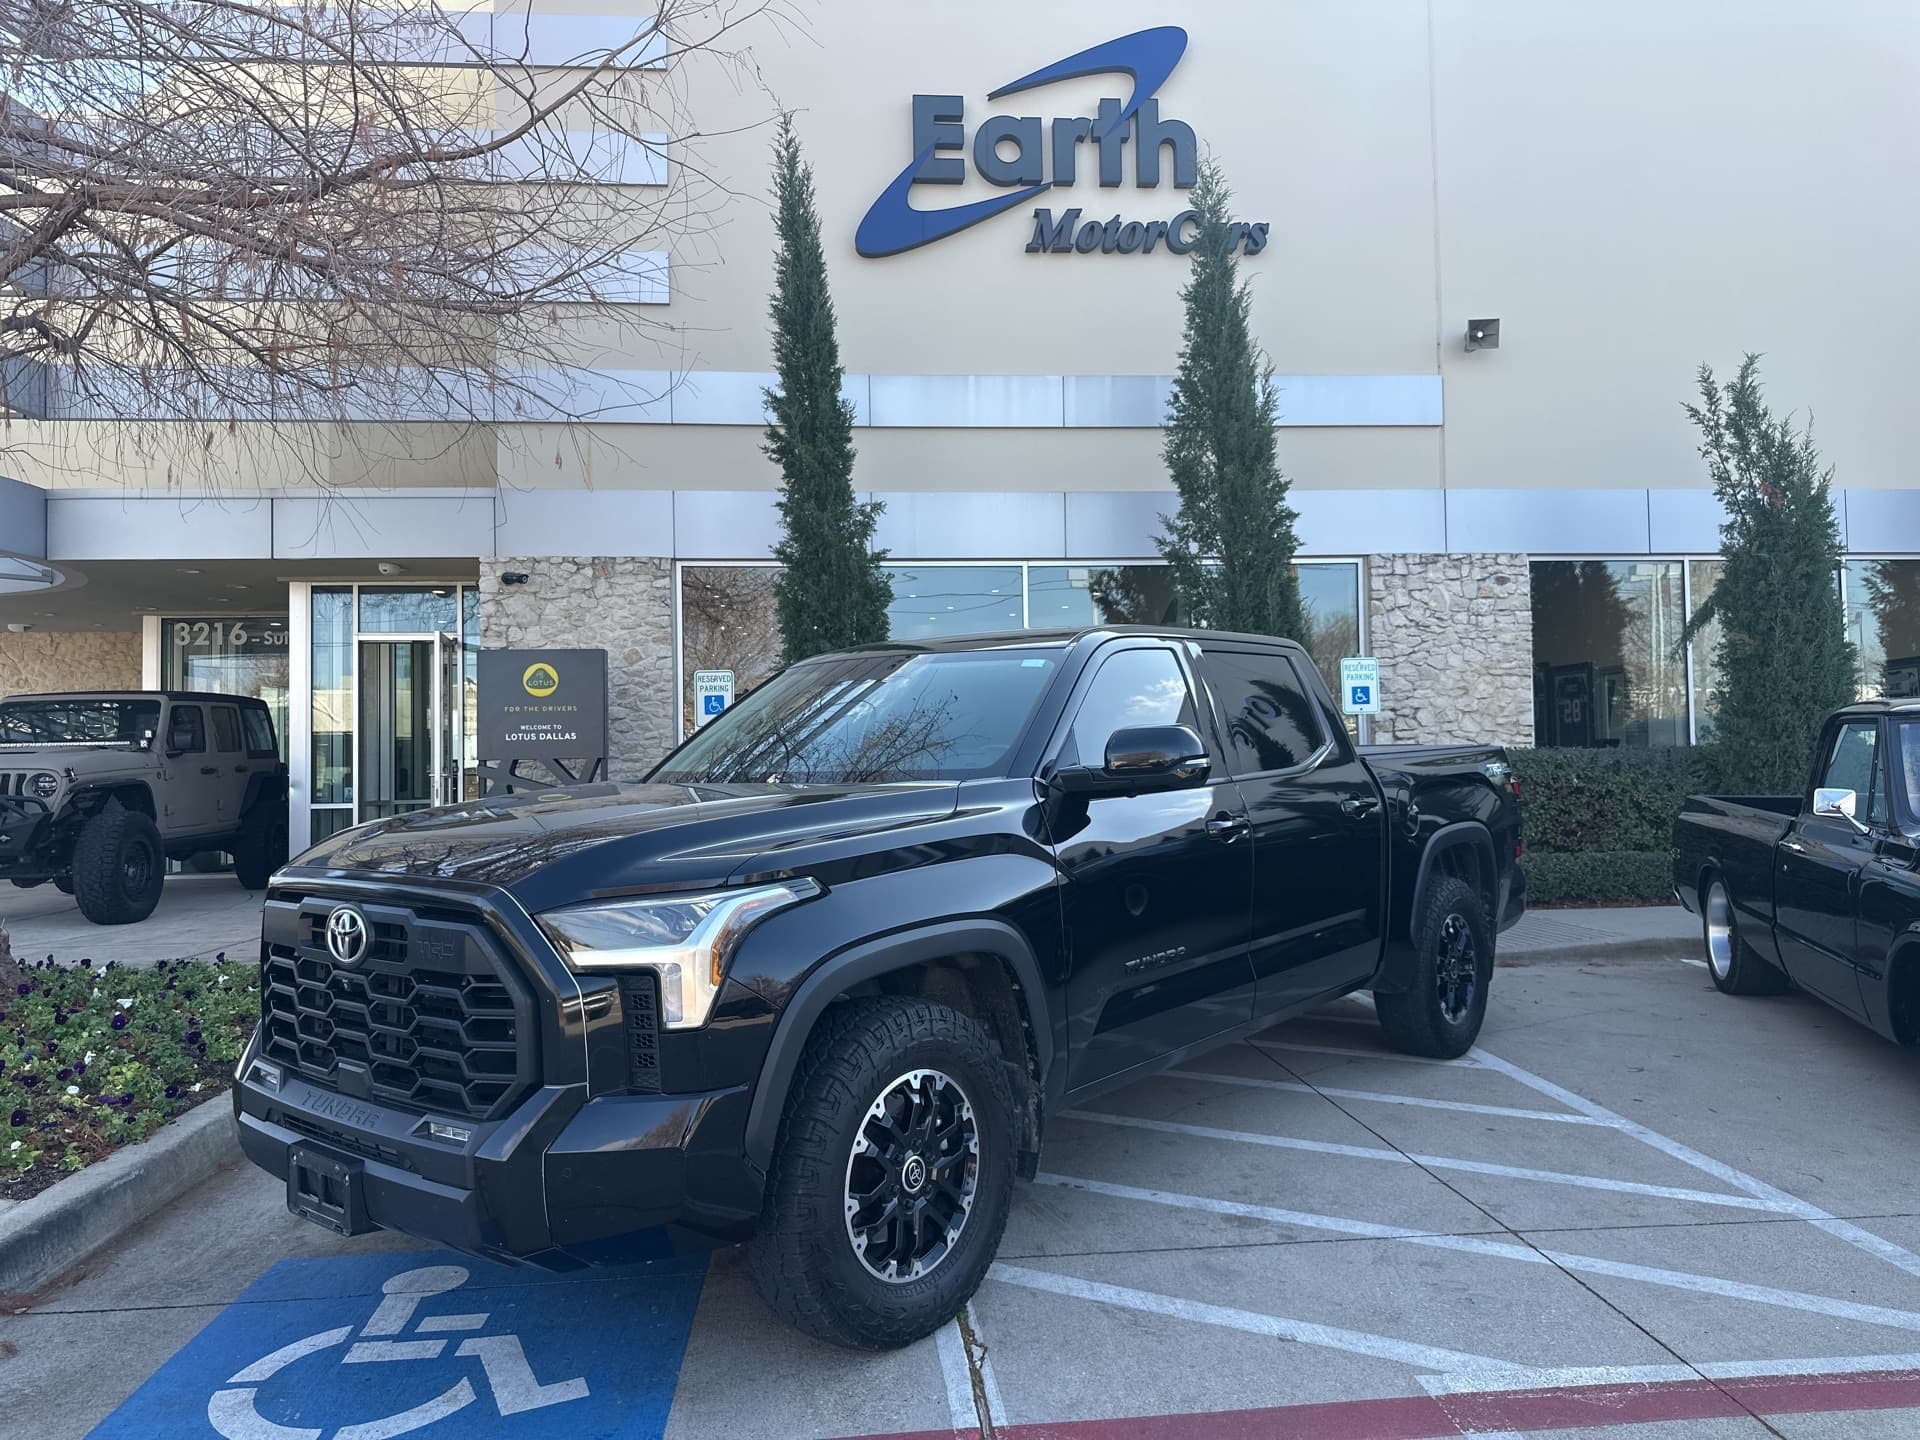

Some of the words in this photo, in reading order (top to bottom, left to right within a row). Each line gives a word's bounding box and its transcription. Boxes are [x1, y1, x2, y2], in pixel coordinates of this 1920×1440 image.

[912, 94, 1197, 189] Earth
[1025, 207, 1270, 256] MotorCrs
[697, 675, 731, 683] RESERVED
[1346, 673, 1375, 681] PARKING
[699, 684, 729, 692] PARKING
[505, 733, 537, 741] LOTUS
[539, 732, 577, 740] DALLAS
